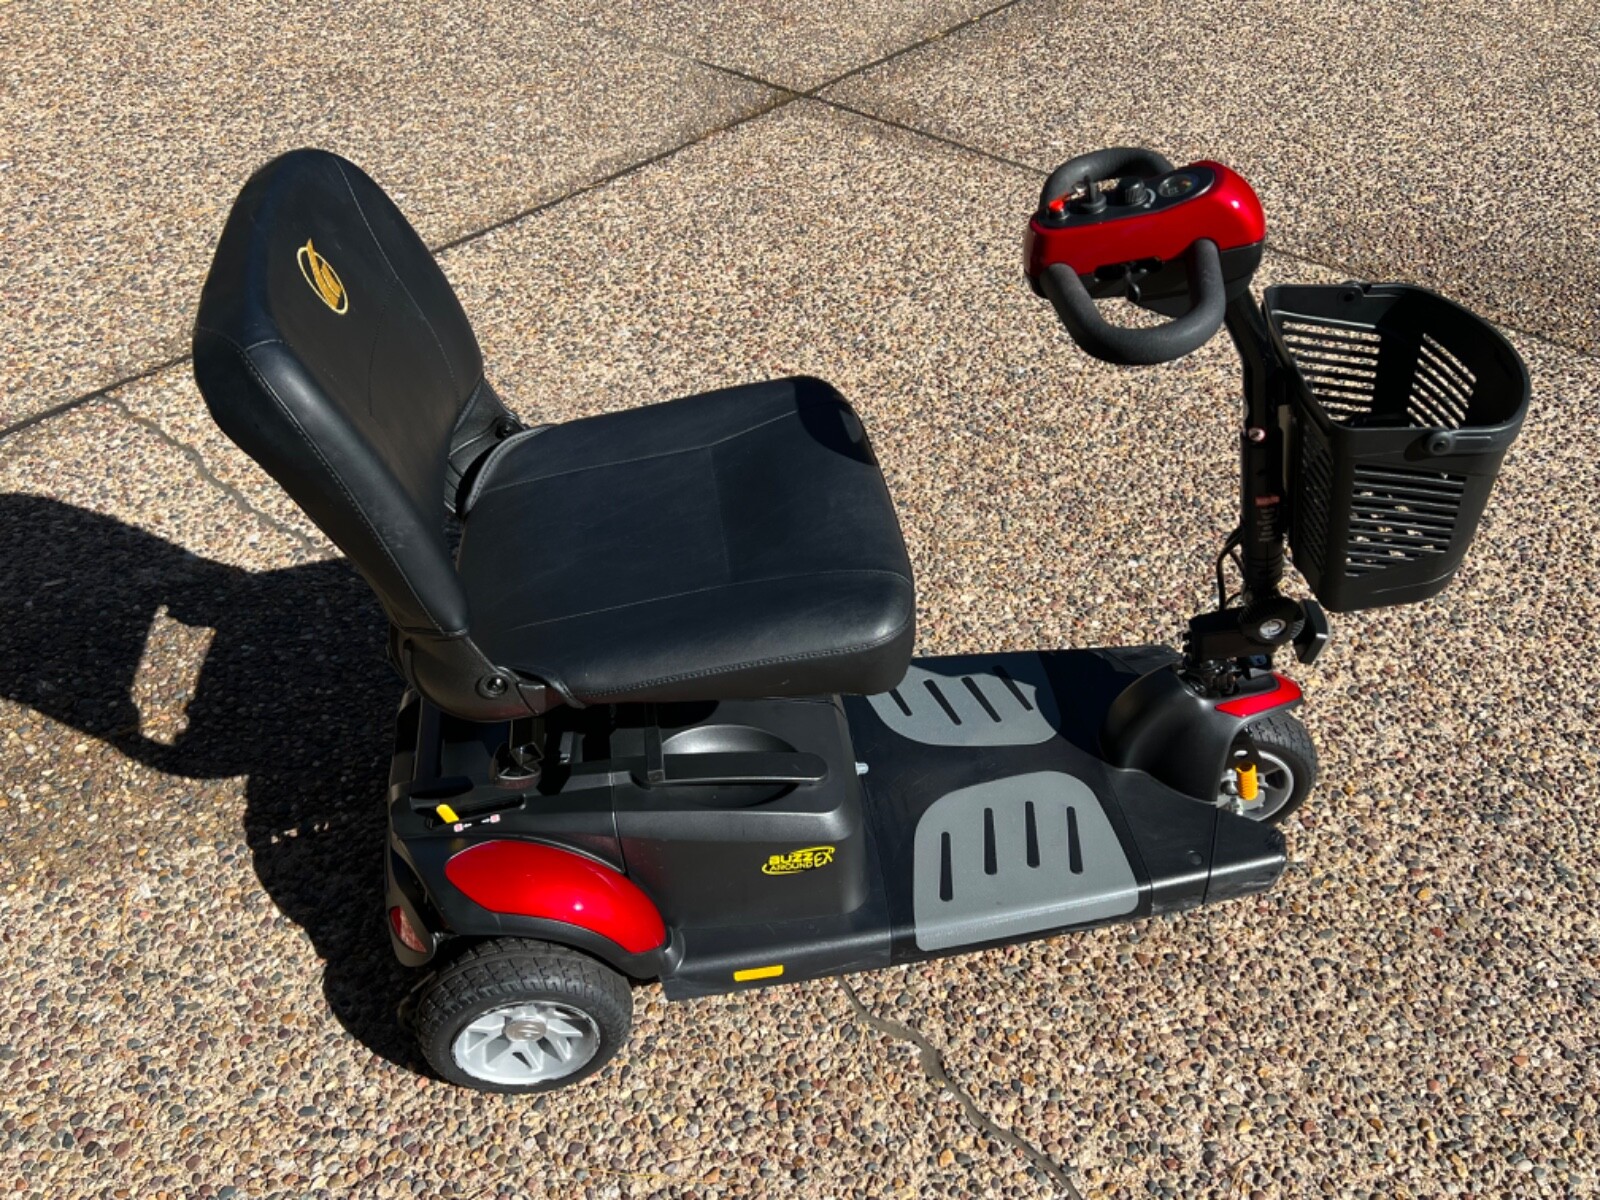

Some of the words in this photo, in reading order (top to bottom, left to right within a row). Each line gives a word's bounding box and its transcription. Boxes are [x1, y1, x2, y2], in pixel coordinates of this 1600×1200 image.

[769, 851, 813, 865] BUZZ
[814, 851, 833, 867] EX
[769, 861, 813, 872] AROUND
